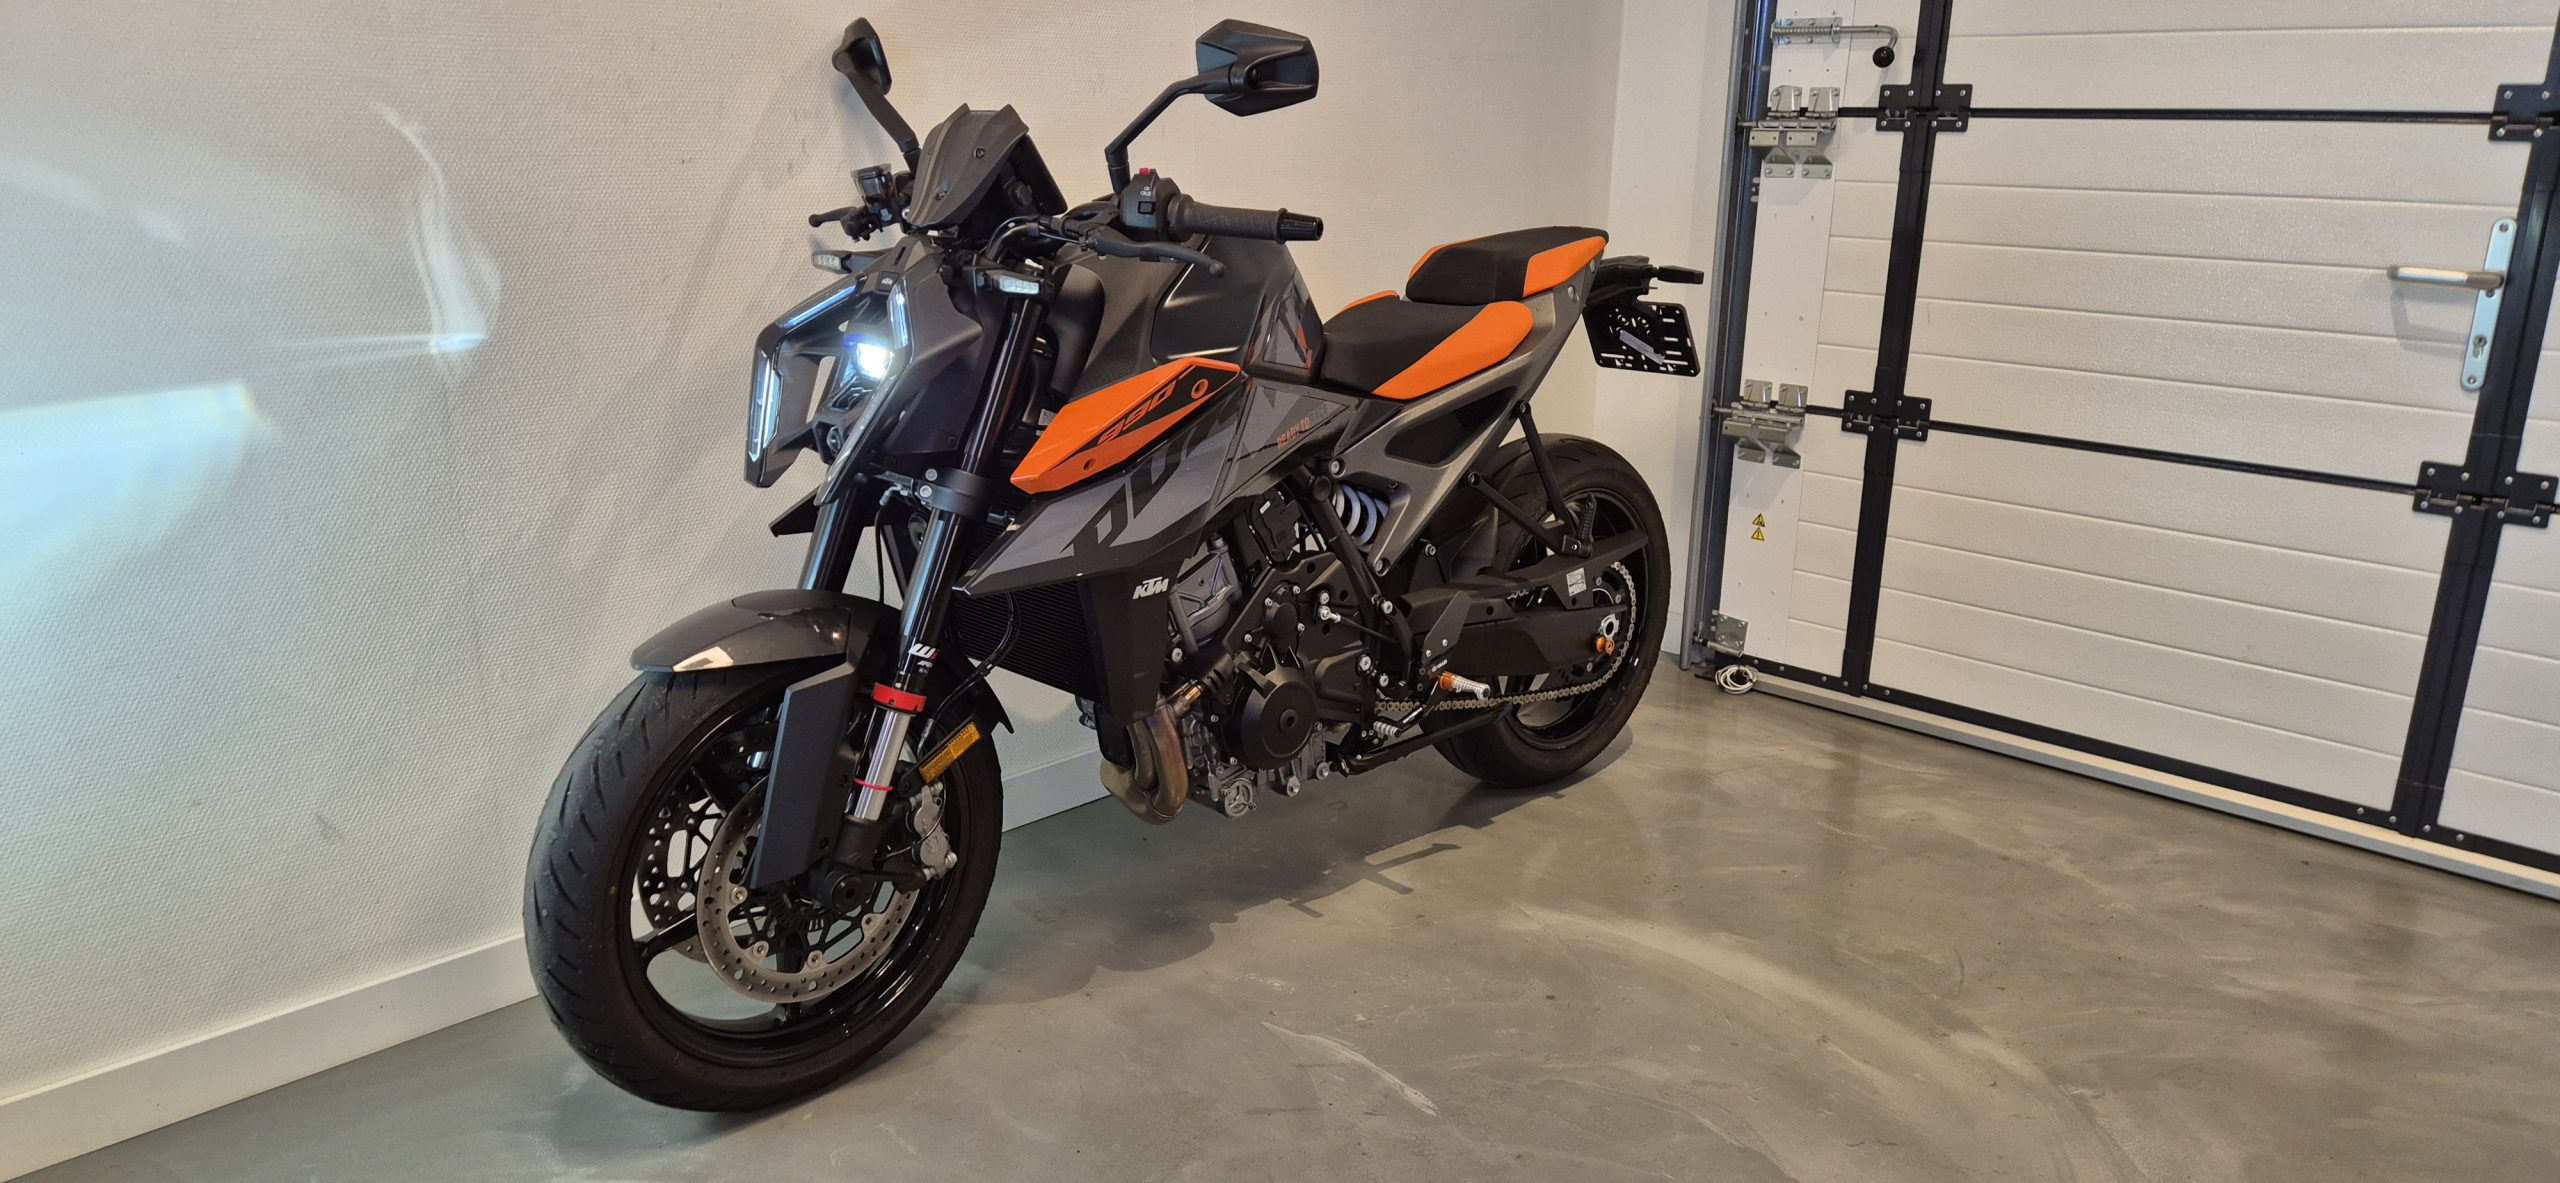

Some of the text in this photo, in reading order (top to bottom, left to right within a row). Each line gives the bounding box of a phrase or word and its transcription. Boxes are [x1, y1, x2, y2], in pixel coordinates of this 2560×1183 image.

[1097, 379, 1177, 446] 990
[1277, 423, 1299, 449] READY
[1132, 576, 1169, 600] KTM
